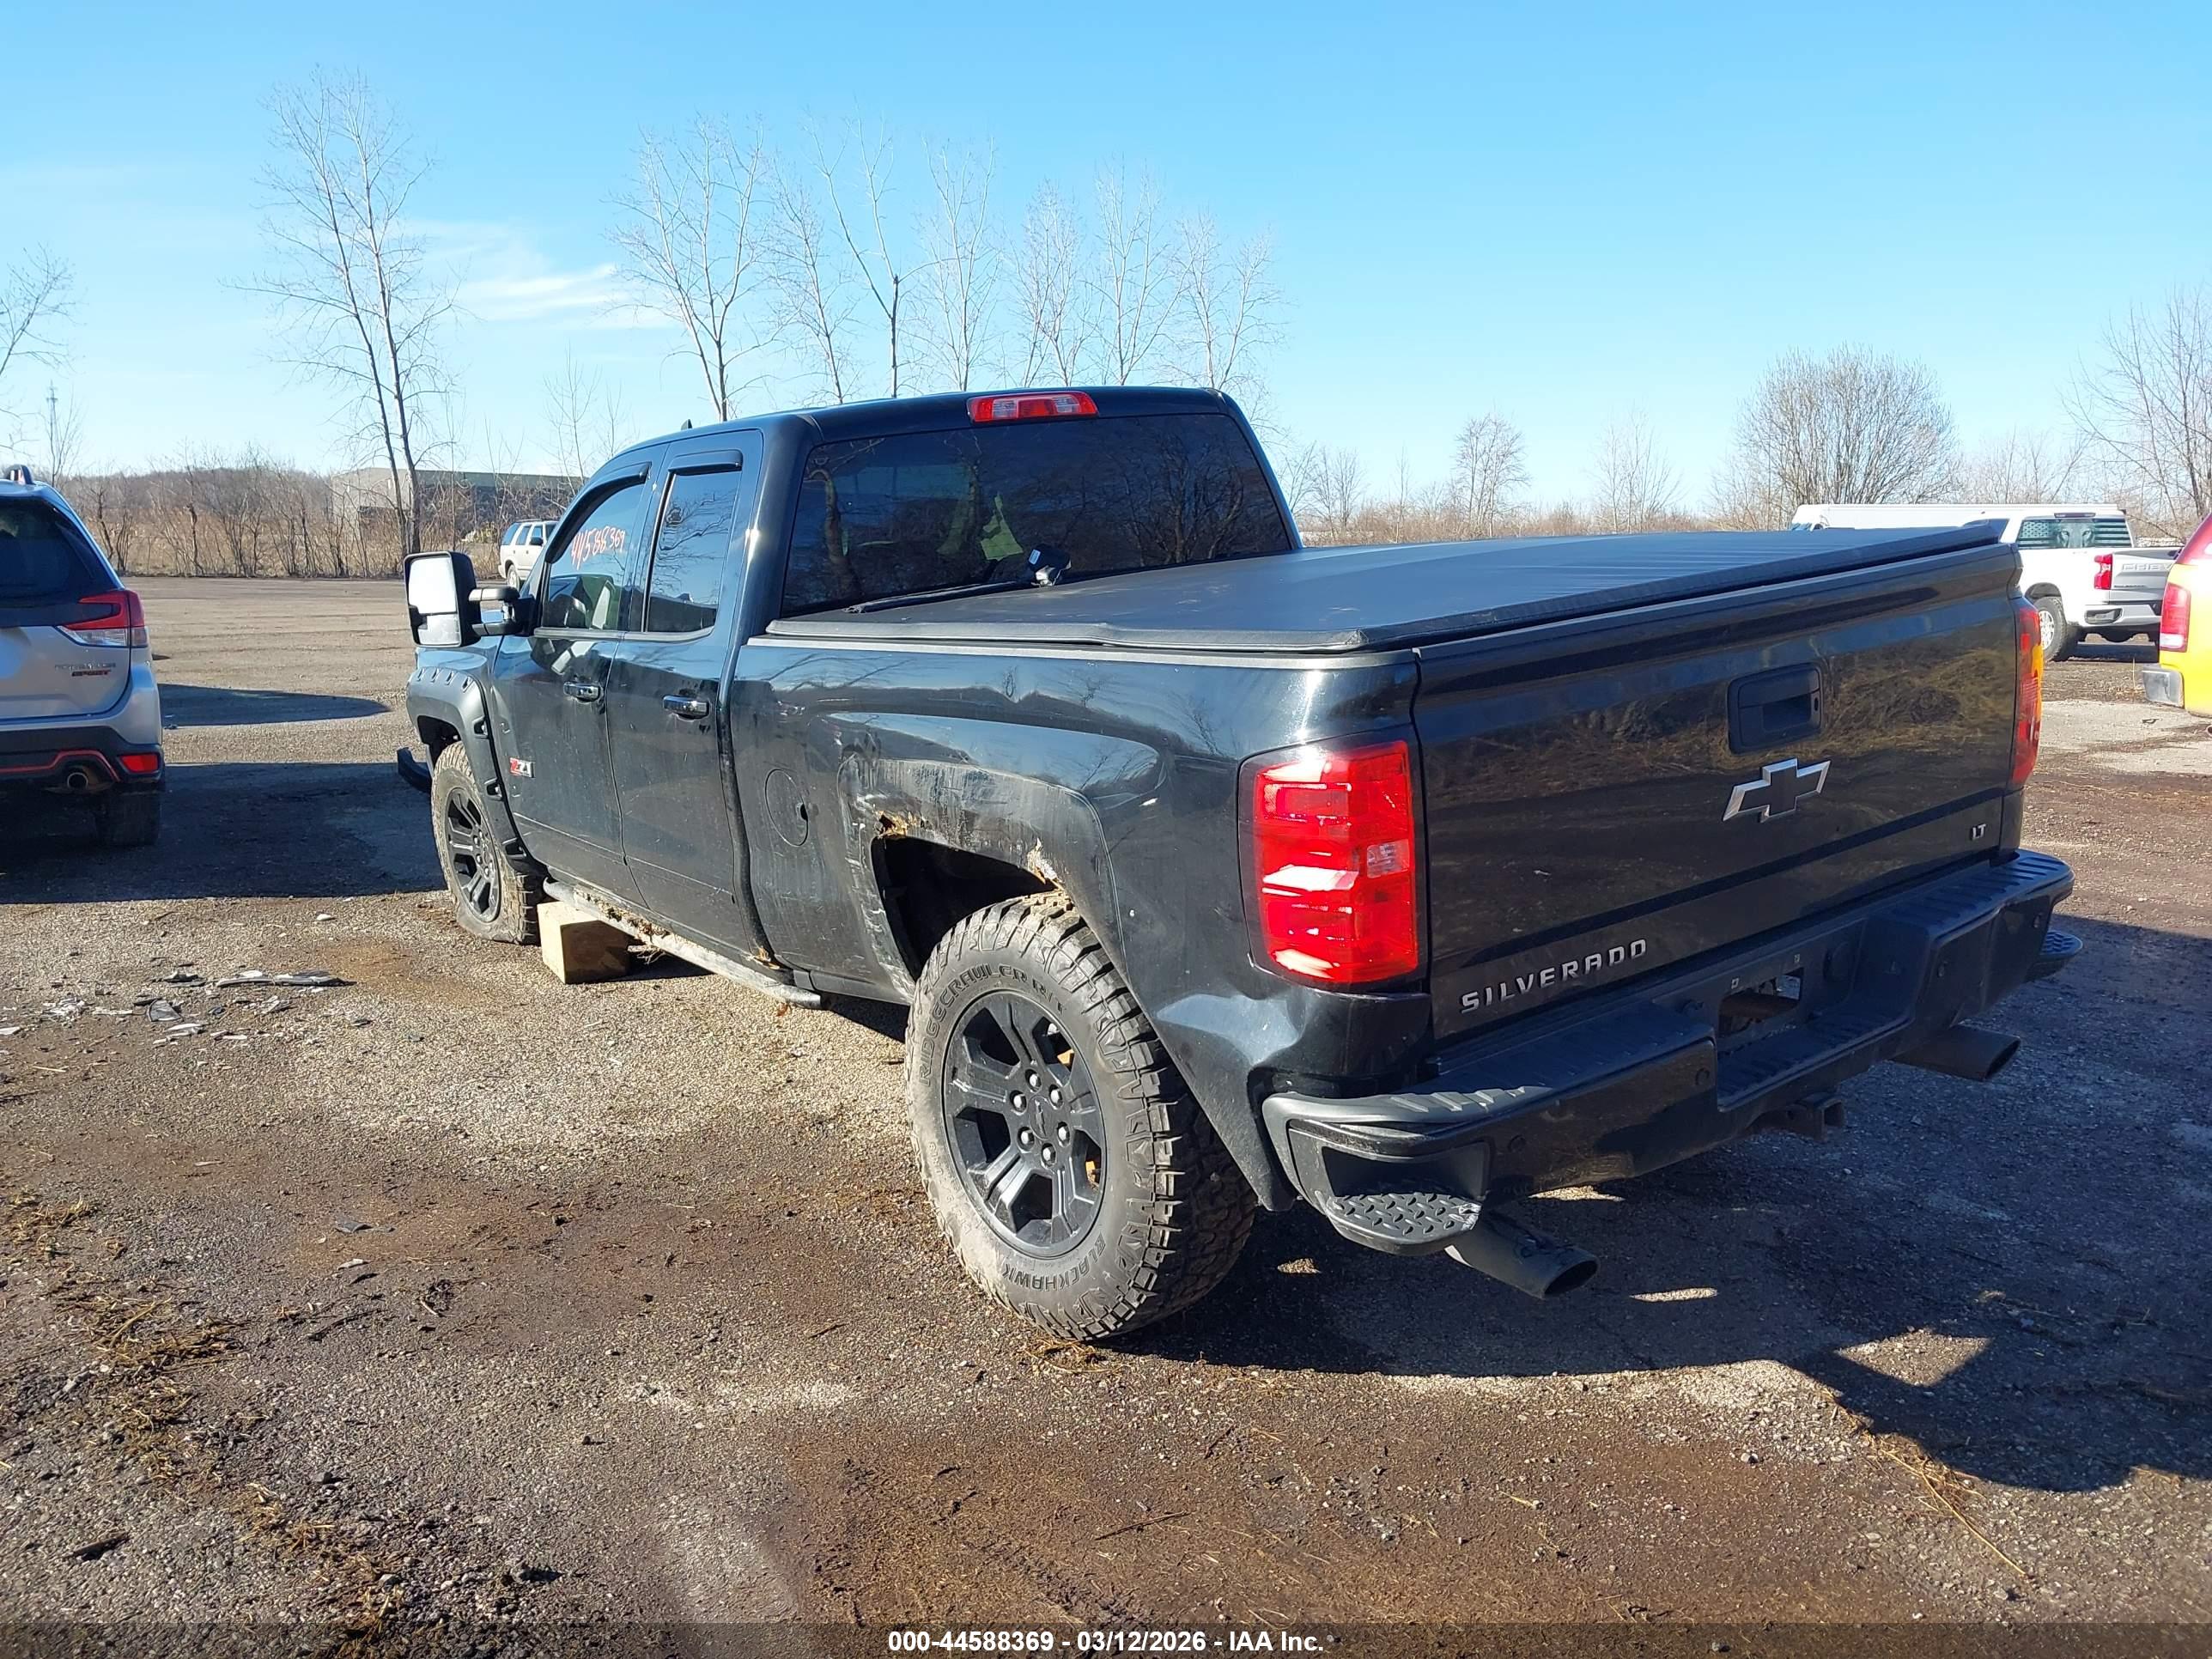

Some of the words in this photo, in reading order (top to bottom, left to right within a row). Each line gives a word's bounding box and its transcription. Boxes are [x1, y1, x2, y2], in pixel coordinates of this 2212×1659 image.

[509, 757, 536, 778] Z71
[1972, 823, 1987, 841] LT
[1461, 939, 1648, 1014] SILVERADO
[920, 963, 1028, 1087] RIDGECRAWLER
[1001, 1231, 1106, 1292] BLACKHAWK
